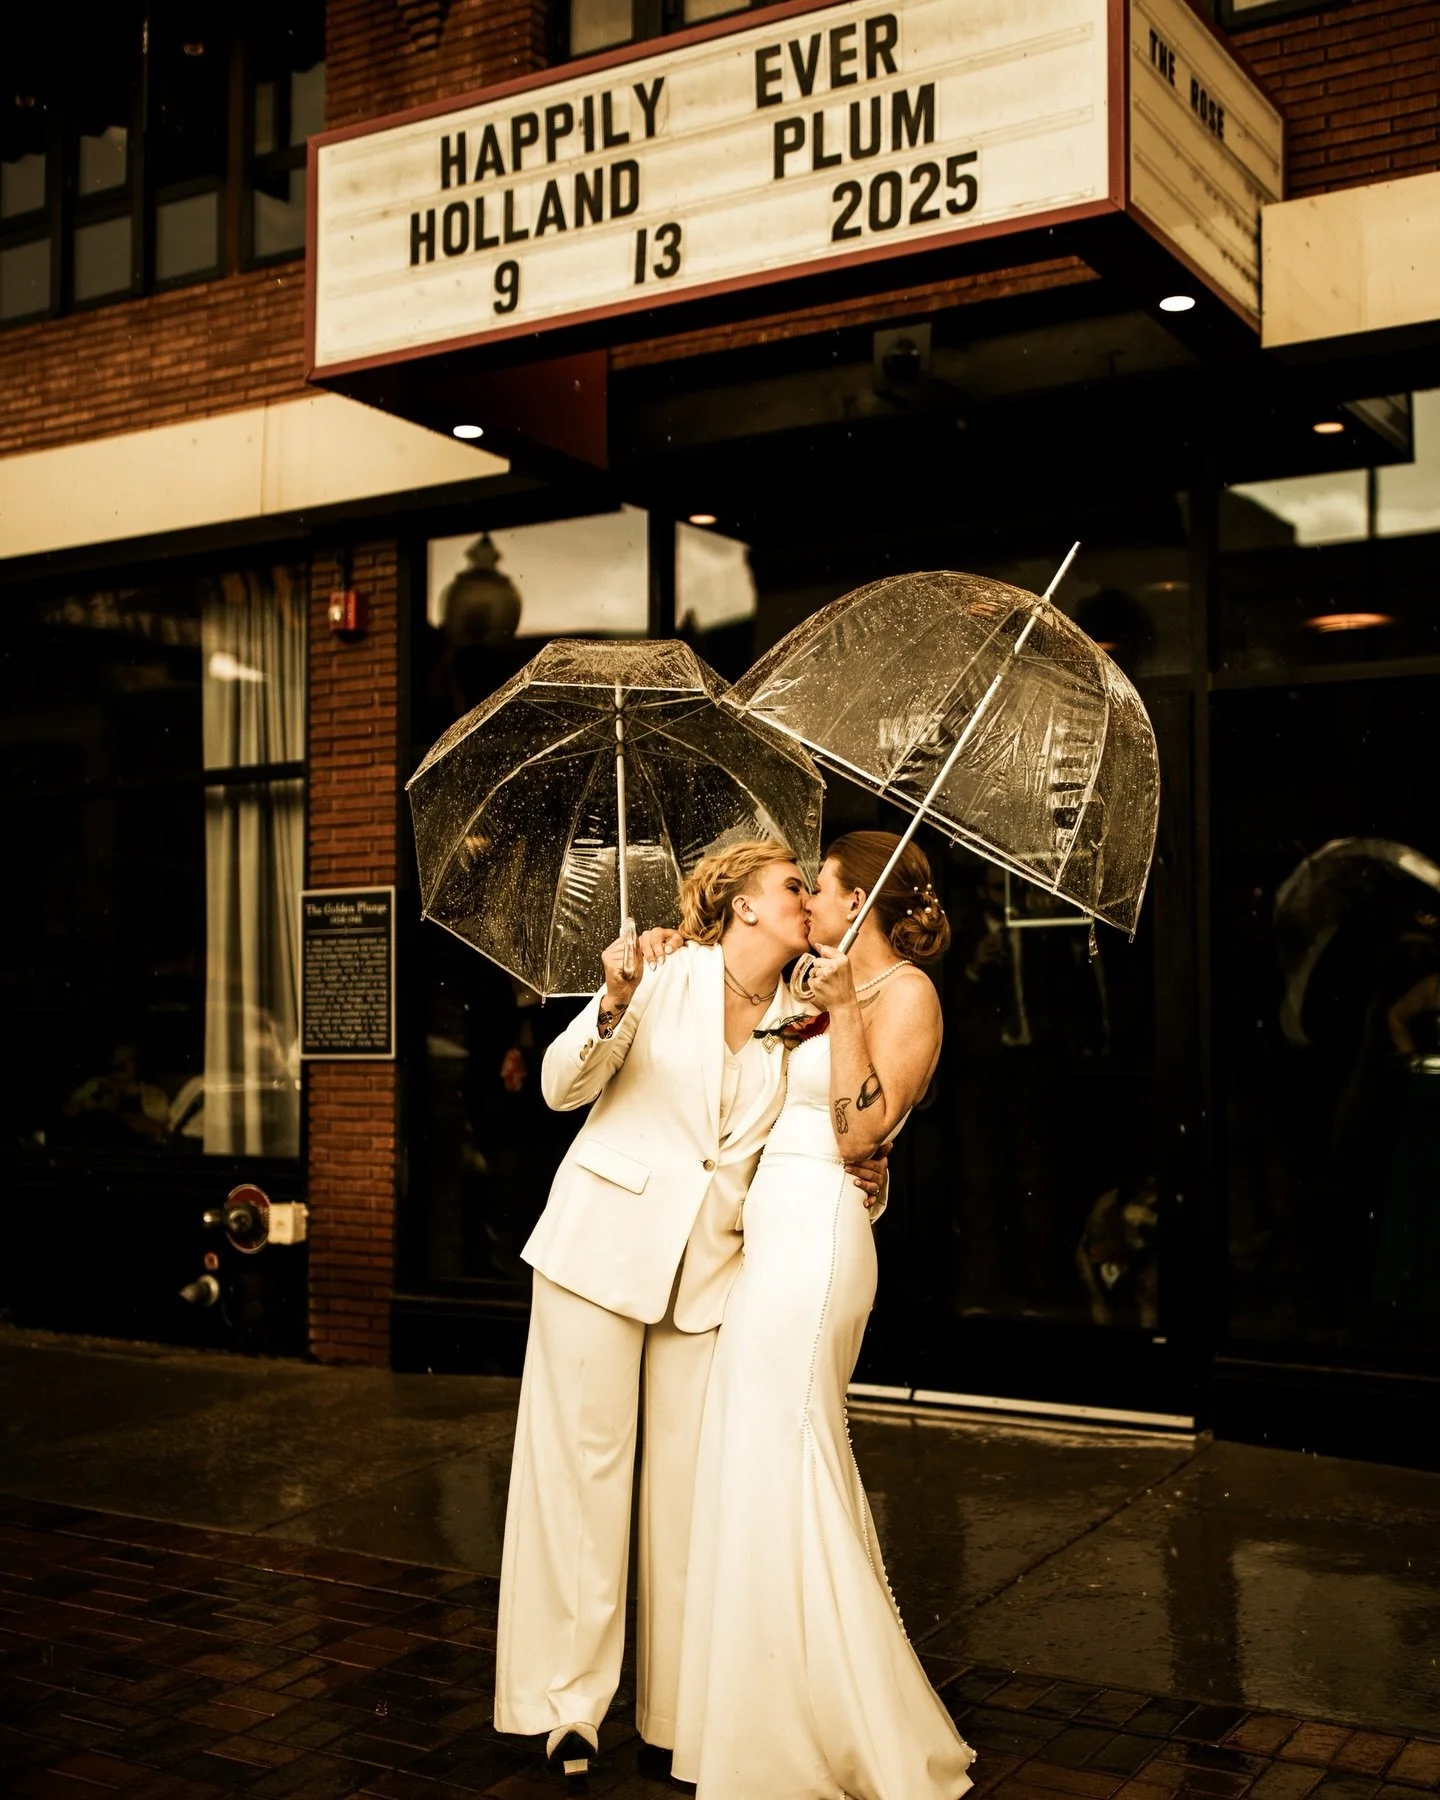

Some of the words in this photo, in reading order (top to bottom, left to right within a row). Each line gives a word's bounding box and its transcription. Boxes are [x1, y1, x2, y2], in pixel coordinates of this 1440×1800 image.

[441, 77, 665, 190] HAPPILY
[756, 14, 898, 109] EVER
[1149, 28, 1176, 89] THE
[1191, 77, 1225, 142] ROSE
[411, 159, 640, 266] HOLLAND
[774, 83, 936, 180] PLUM
[494, 260, 520, 314] 9
[635, 223, 682, 284] 13
[832, 151, 978, 242] 2025
[306, 903, 322, 916] The
[323, 902, 355, 916] Golden
[357, 901, 387, 915] Plunge
